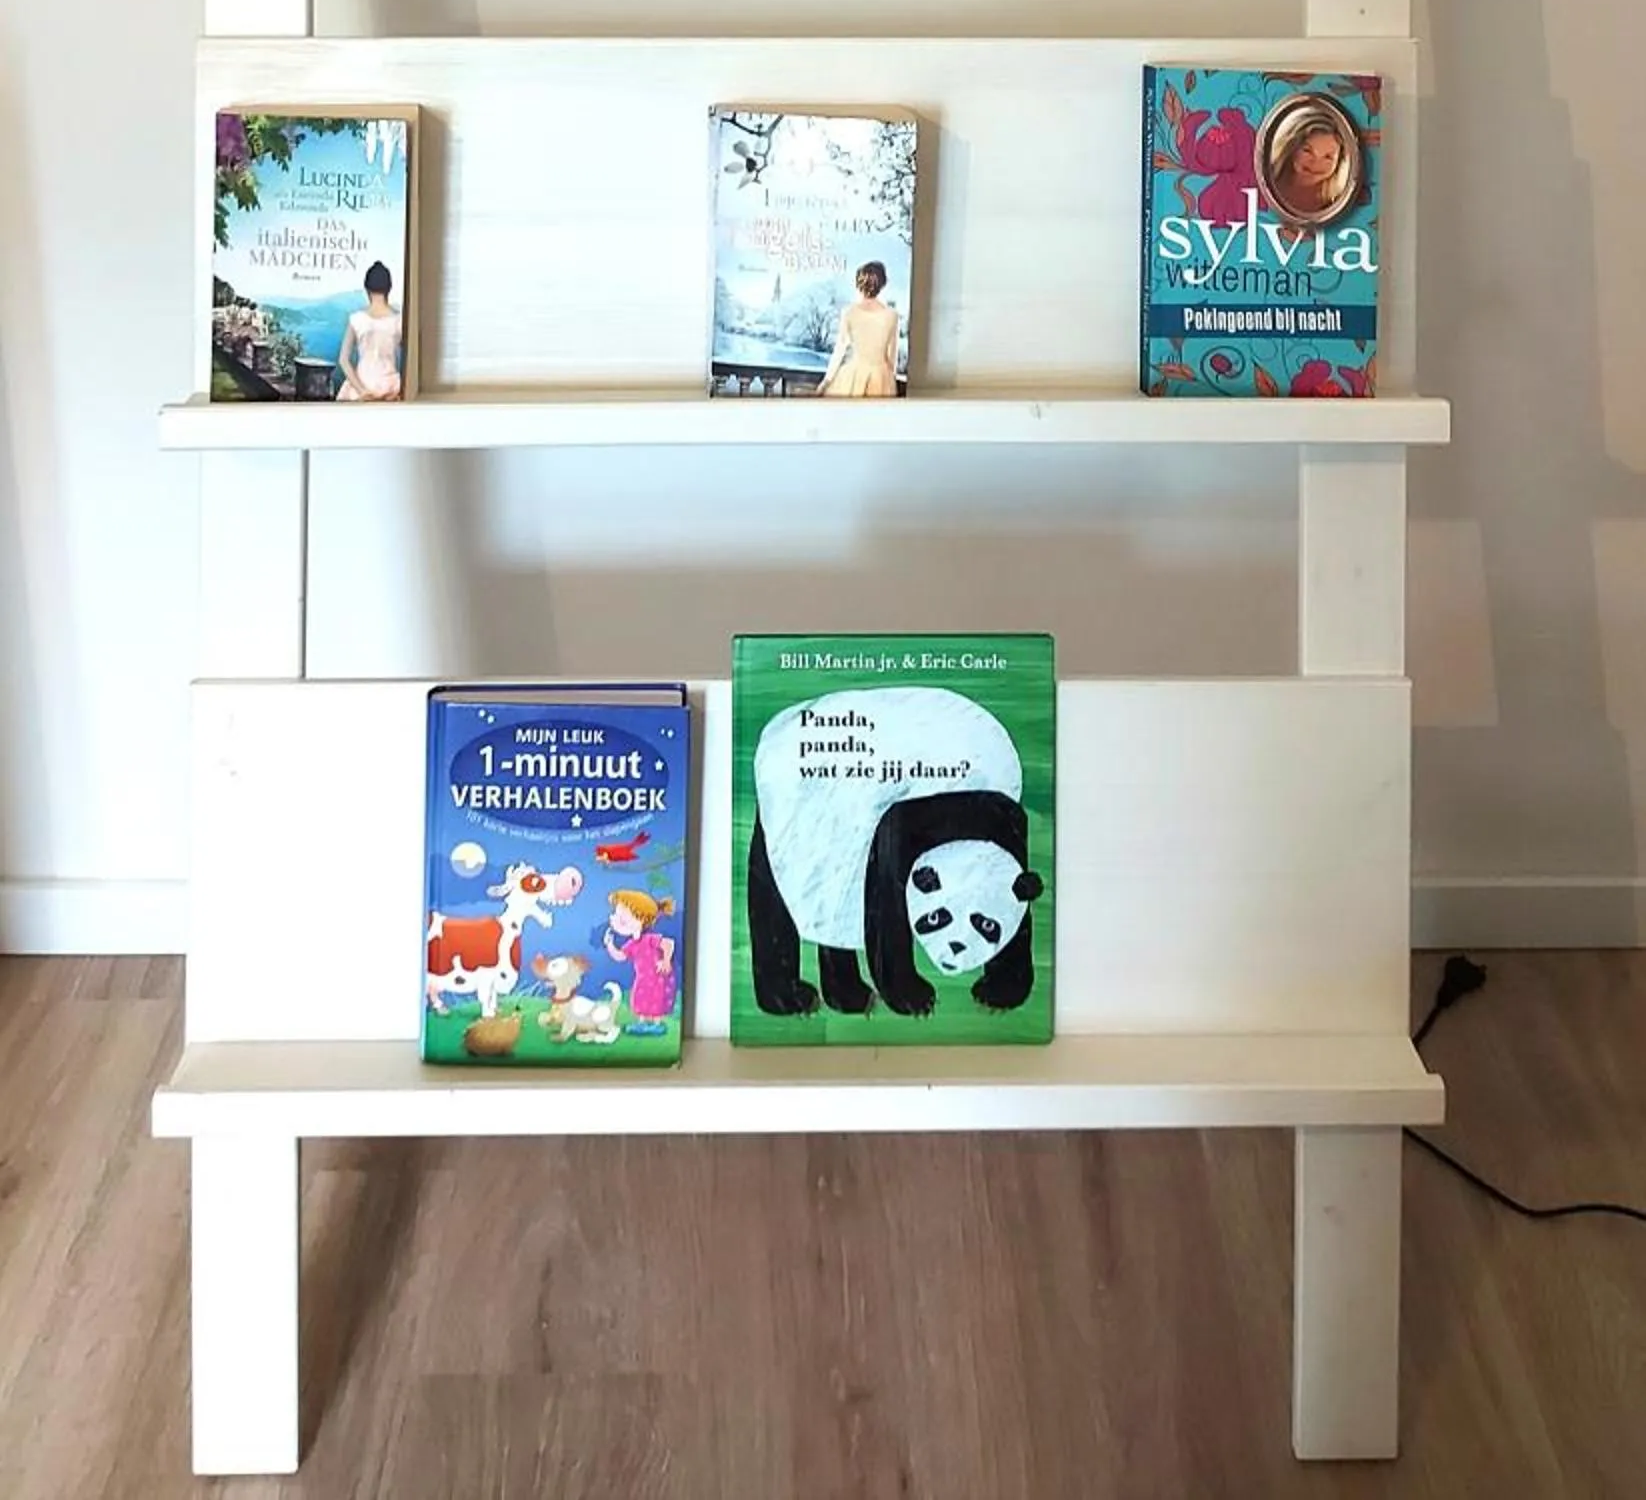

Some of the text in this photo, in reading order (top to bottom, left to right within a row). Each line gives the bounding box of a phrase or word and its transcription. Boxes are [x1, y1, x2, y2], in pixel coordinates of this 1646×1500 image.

[317, 217, 347, 232] DAS
[1158, 187, 1378, 285] sylvia
[1166, 258, 1312, 298] witteman
[1184, 308, 1342, 334] Pekingeend bij nacht
[780, 653, 808, 669] Bill
[814, 653, 875, 669] Martin
[902, 654, 917, 669] &
[920, 653, 957, 669] Eric
[961, 653, 1007, 669] Carle
[799, 710, 875, 730] Panda,
[515, 728, 605, 745] MIJN LEUK
[800, 736, 875, 758] panda,
[479, 746, 642, 779] 1-minuut
[800, 760, 970, 783] wat zie jij daar?
[451, 786, 667, 811] VERHALENBOEK
